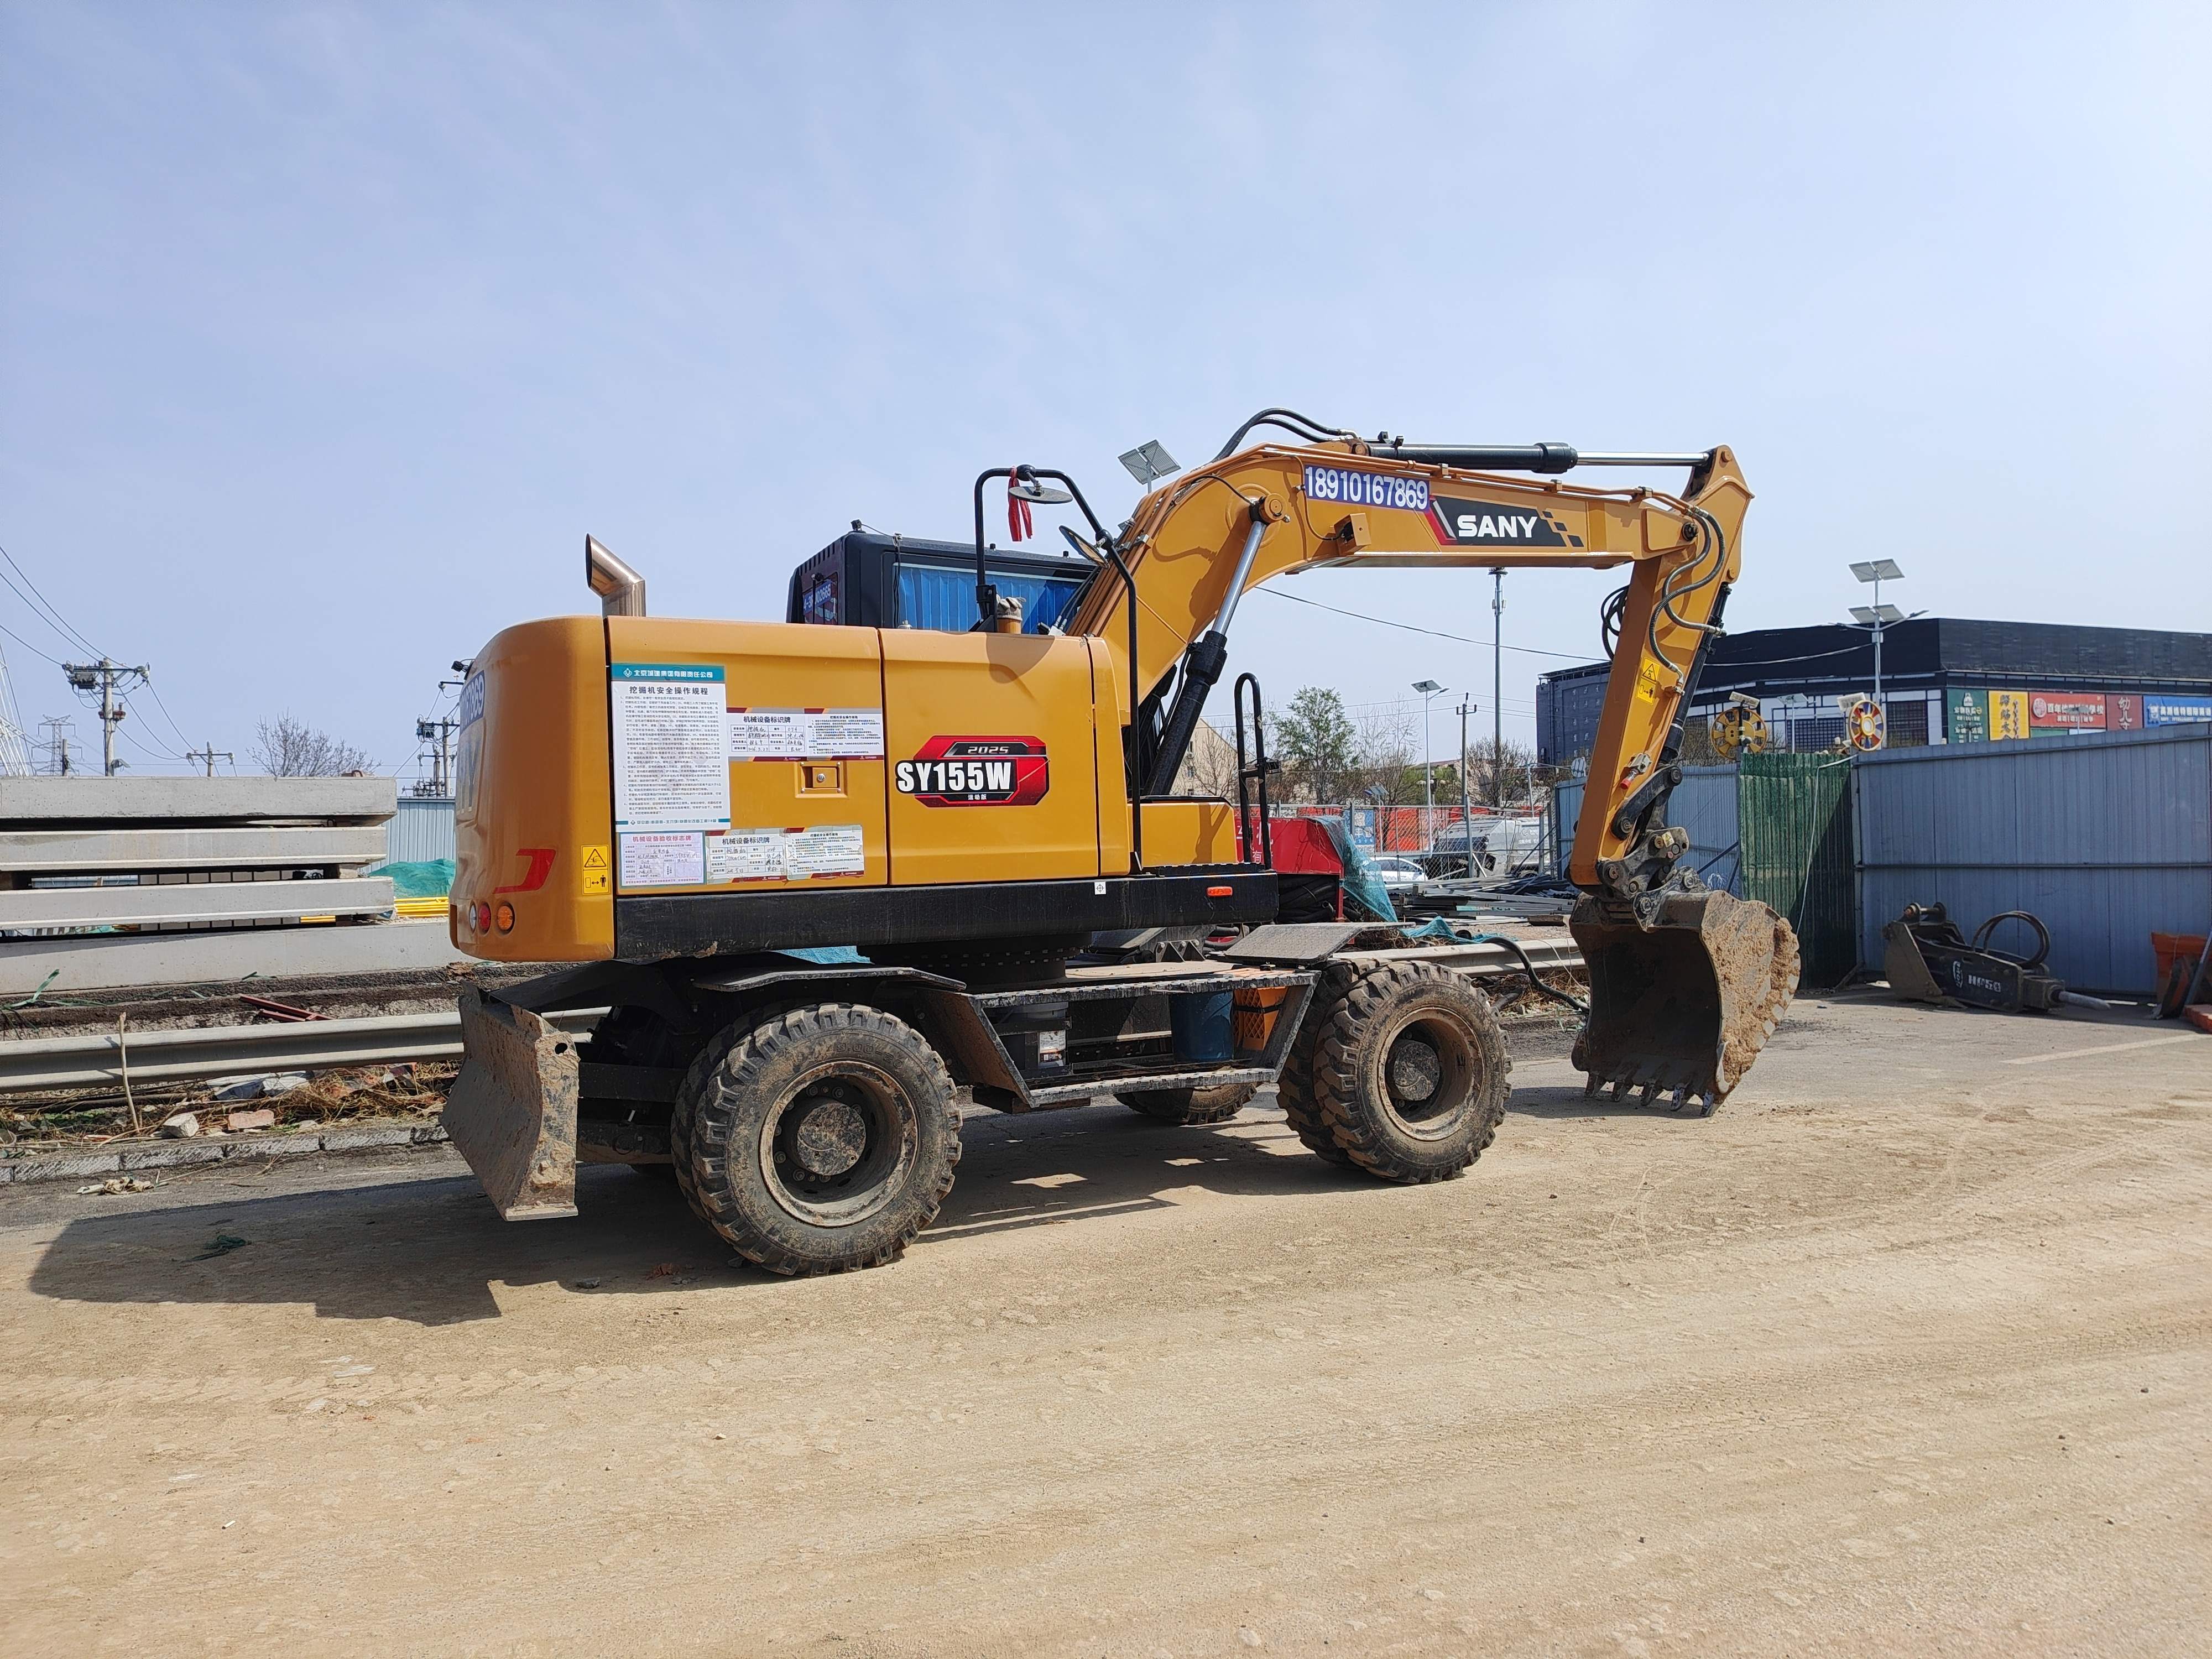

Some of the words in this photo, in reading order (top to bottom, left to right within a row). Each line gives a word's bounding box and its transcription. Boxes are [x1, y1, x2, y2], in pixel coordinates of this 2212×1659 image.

[1306, 466, 1428, 510] 18910167869
[1457, 515, 1538, 538] SANY
[634, 670, 713, 678] 北京城建集团有限责任公司
[629, 686, 708, 695] 挖掘机安全操作规程
[897, 762, 1011, 792] SY155W
[722, 837, 770, 845] 机械设备标识牌
